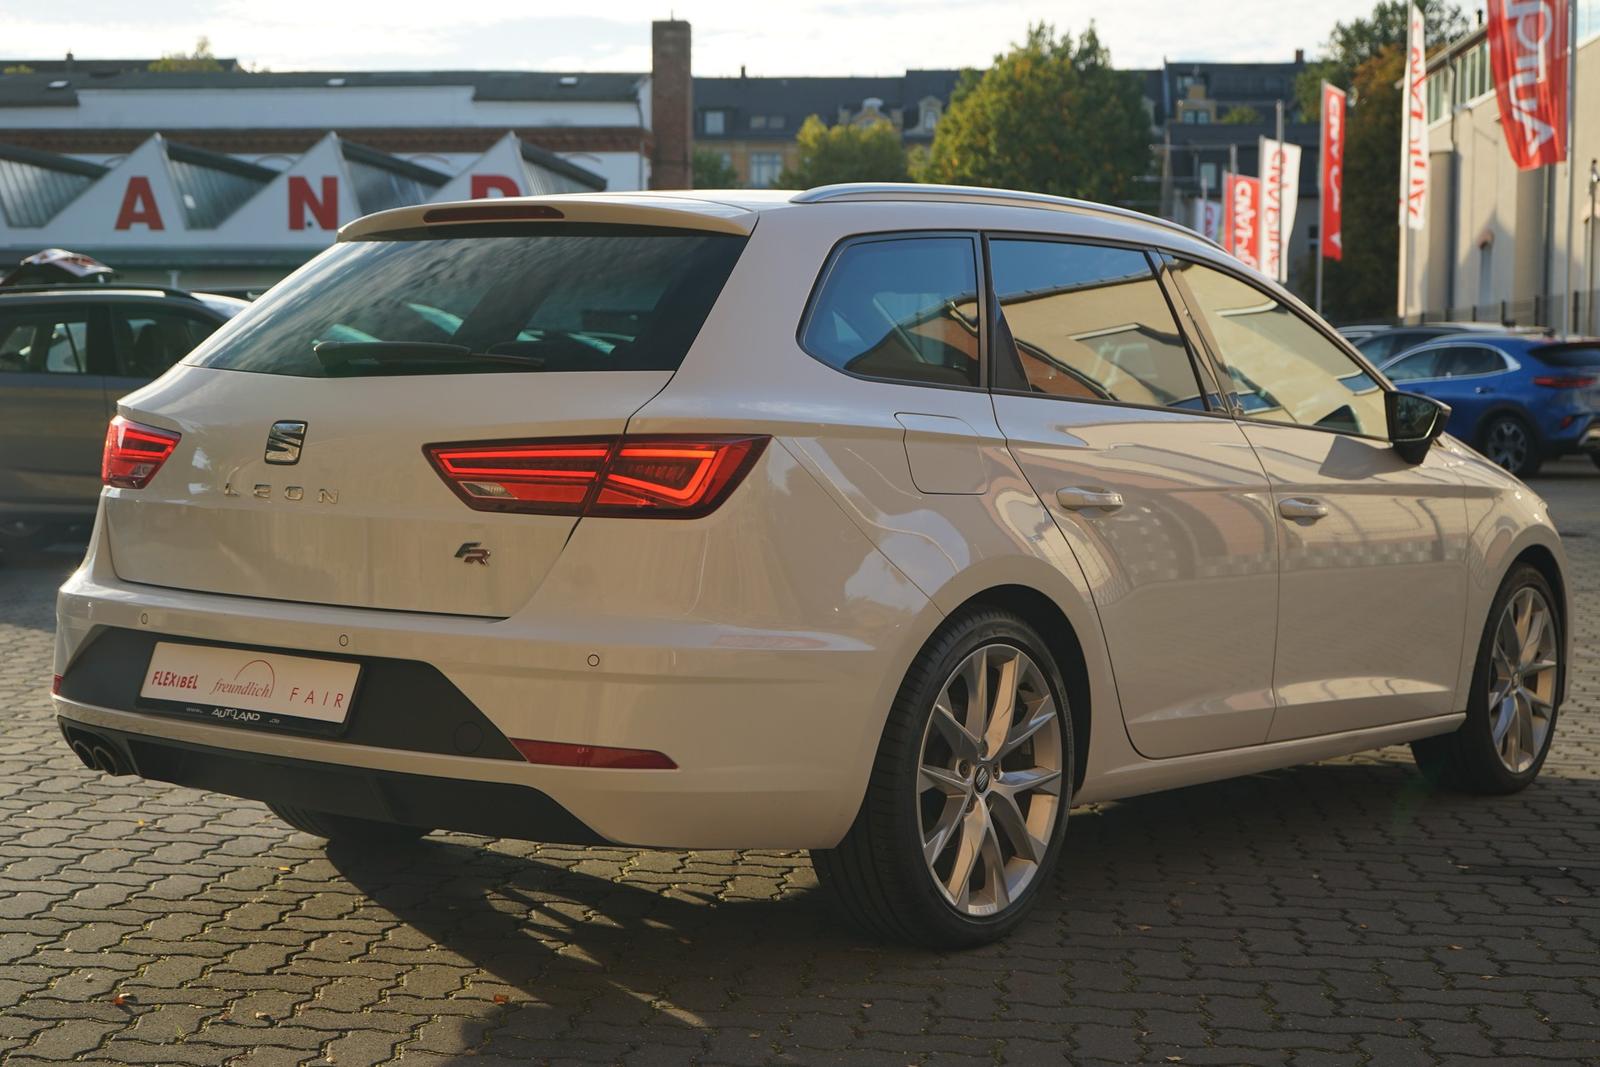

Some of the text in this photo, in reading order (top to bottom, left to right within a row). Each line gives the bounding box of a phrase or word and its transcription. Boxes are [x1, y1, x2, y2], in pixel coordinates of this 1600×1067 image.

[224, 482, 339, 504] LEON
[454, 541, 491, 566] FR
[209, 678, 272, 698] freundlich
[289, 686, 345, 708] FAIR
